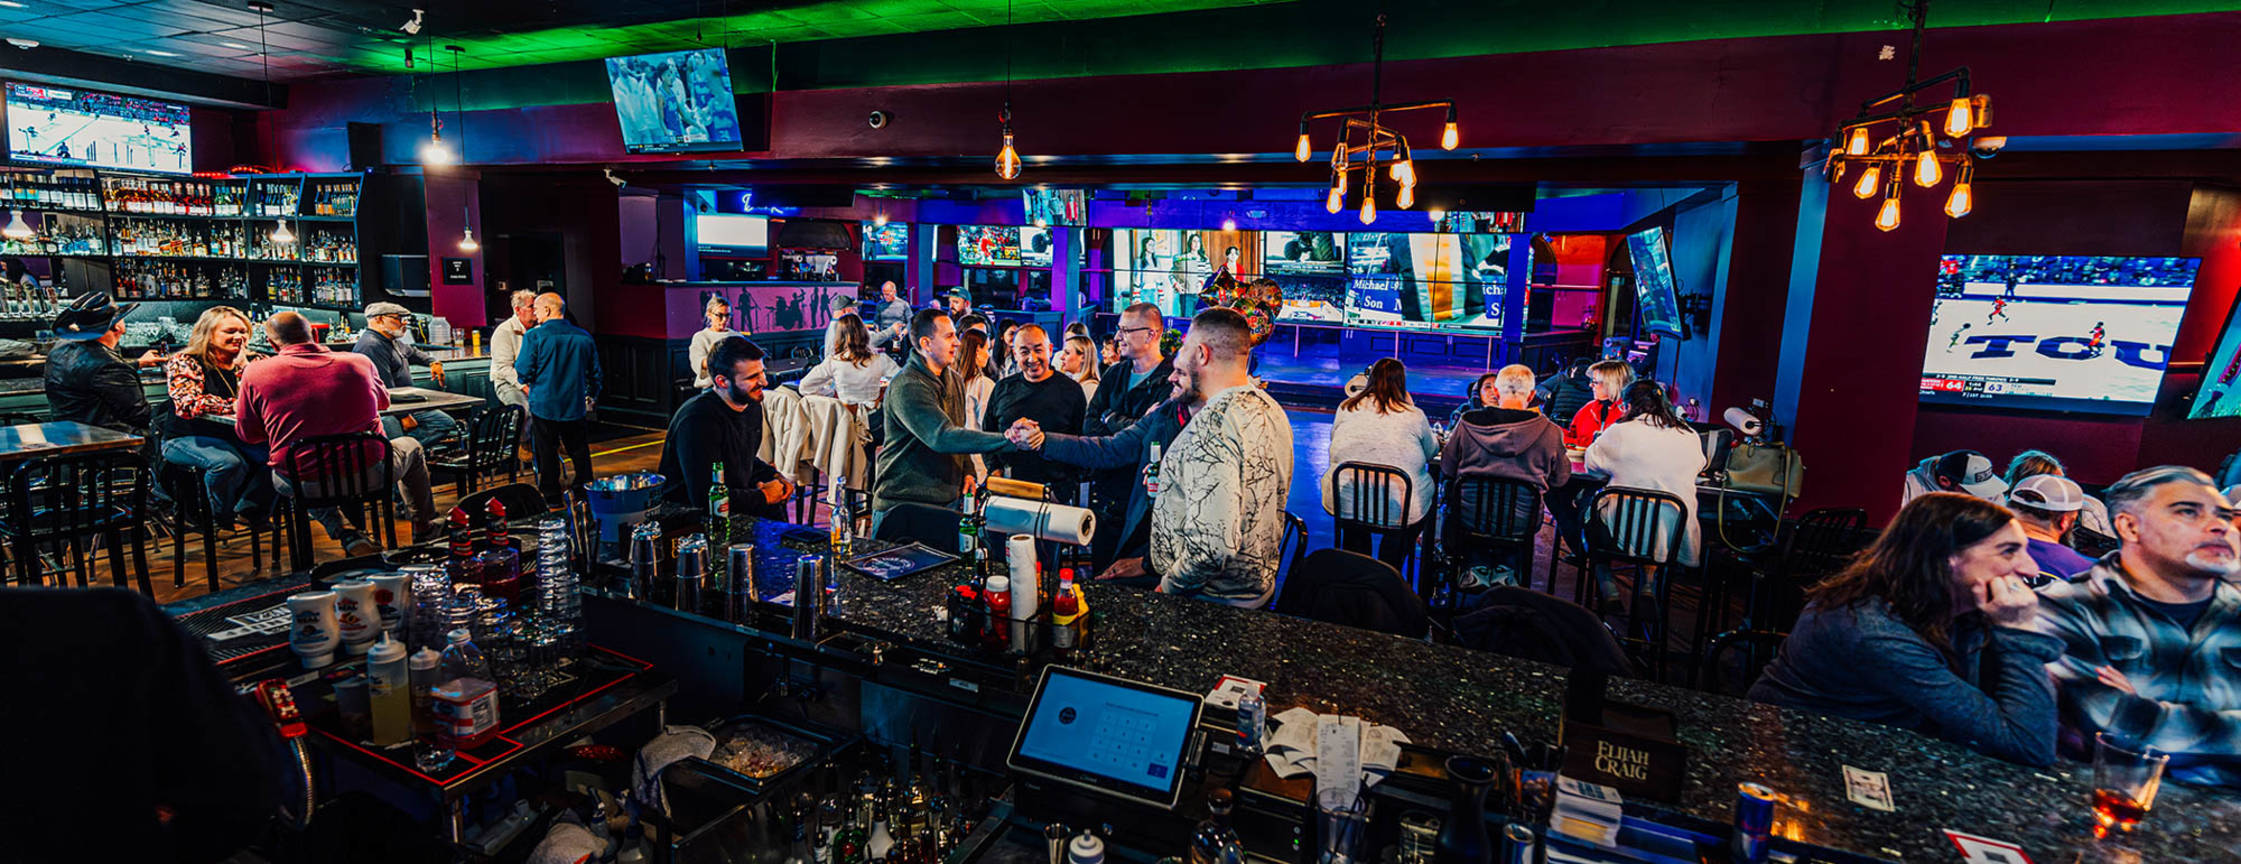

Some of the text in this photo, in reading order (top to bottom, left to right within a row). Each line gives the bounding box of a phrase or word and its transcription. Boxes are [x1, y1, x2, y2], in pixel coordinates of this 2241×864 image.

[1353, 277, 1389, 291] Michael
[1363, 295, 1383, 309] Son
[1945, 381, 1962, 390] 64
[1988, 383, 2003, 392] 63
[1598, 740, 1649, 766] ELIJAH
[1594, 755, 1649, 780] CRAIG
